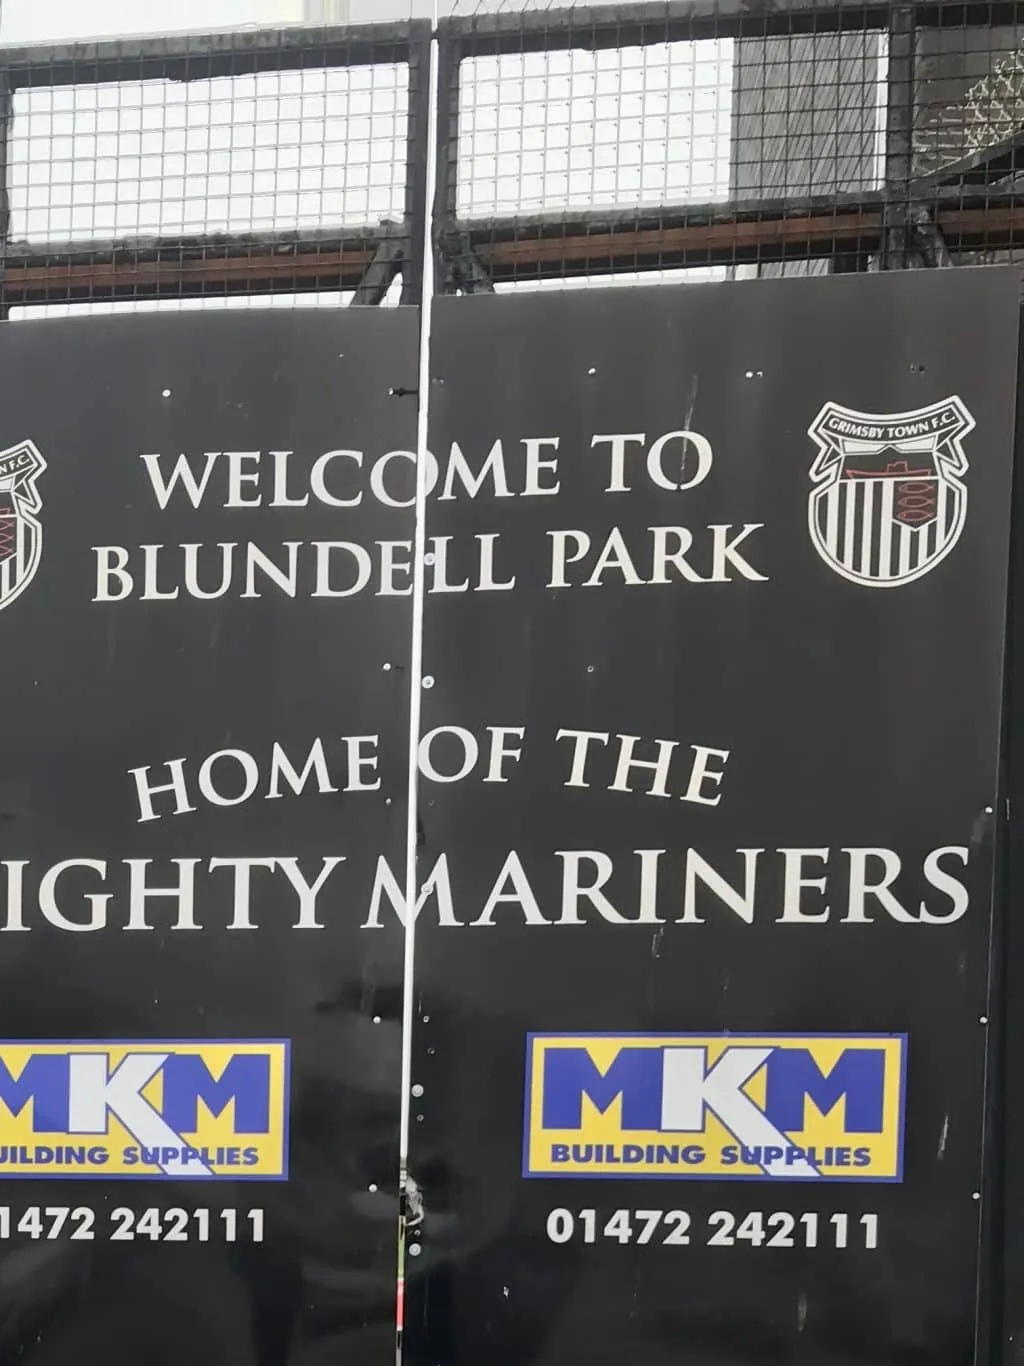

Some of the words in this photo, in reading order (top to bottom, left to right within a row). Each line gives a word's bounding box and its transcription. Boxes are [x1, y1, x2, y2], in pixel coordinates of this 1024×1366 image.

[828, 417, 884, 439] GRIMSBY
[887, 421, 929, 438] TOWN
[931, 411, 956, 429] F.C.
[8, 454, 30, 470] F.C.
[140, 437, 560, 509] WELCOME
[590, 430, 713, 493] TO
[91, 532, 516, 601] BLUNDELL
[546, 523, 769, 588] PARK
[128, 735, 381, 823] HOME
[417, 726, 526, 783] OF
[555, 728, 731, 806] THE
[360, 846, 969, 929] MARINERS
[542, 1045, 886, 1177] MKM
[122, 1146, 260, 1166] SUPPLIES
[551, 1144, 705, 1165] BUILDING
[720, 1145, 871, 1167] SUPPLIES
[109, 1207, 265, 1242] 242111
[546, 1207, 691, 1245] 01472
[706, 1210, 879, 1249] 242111
